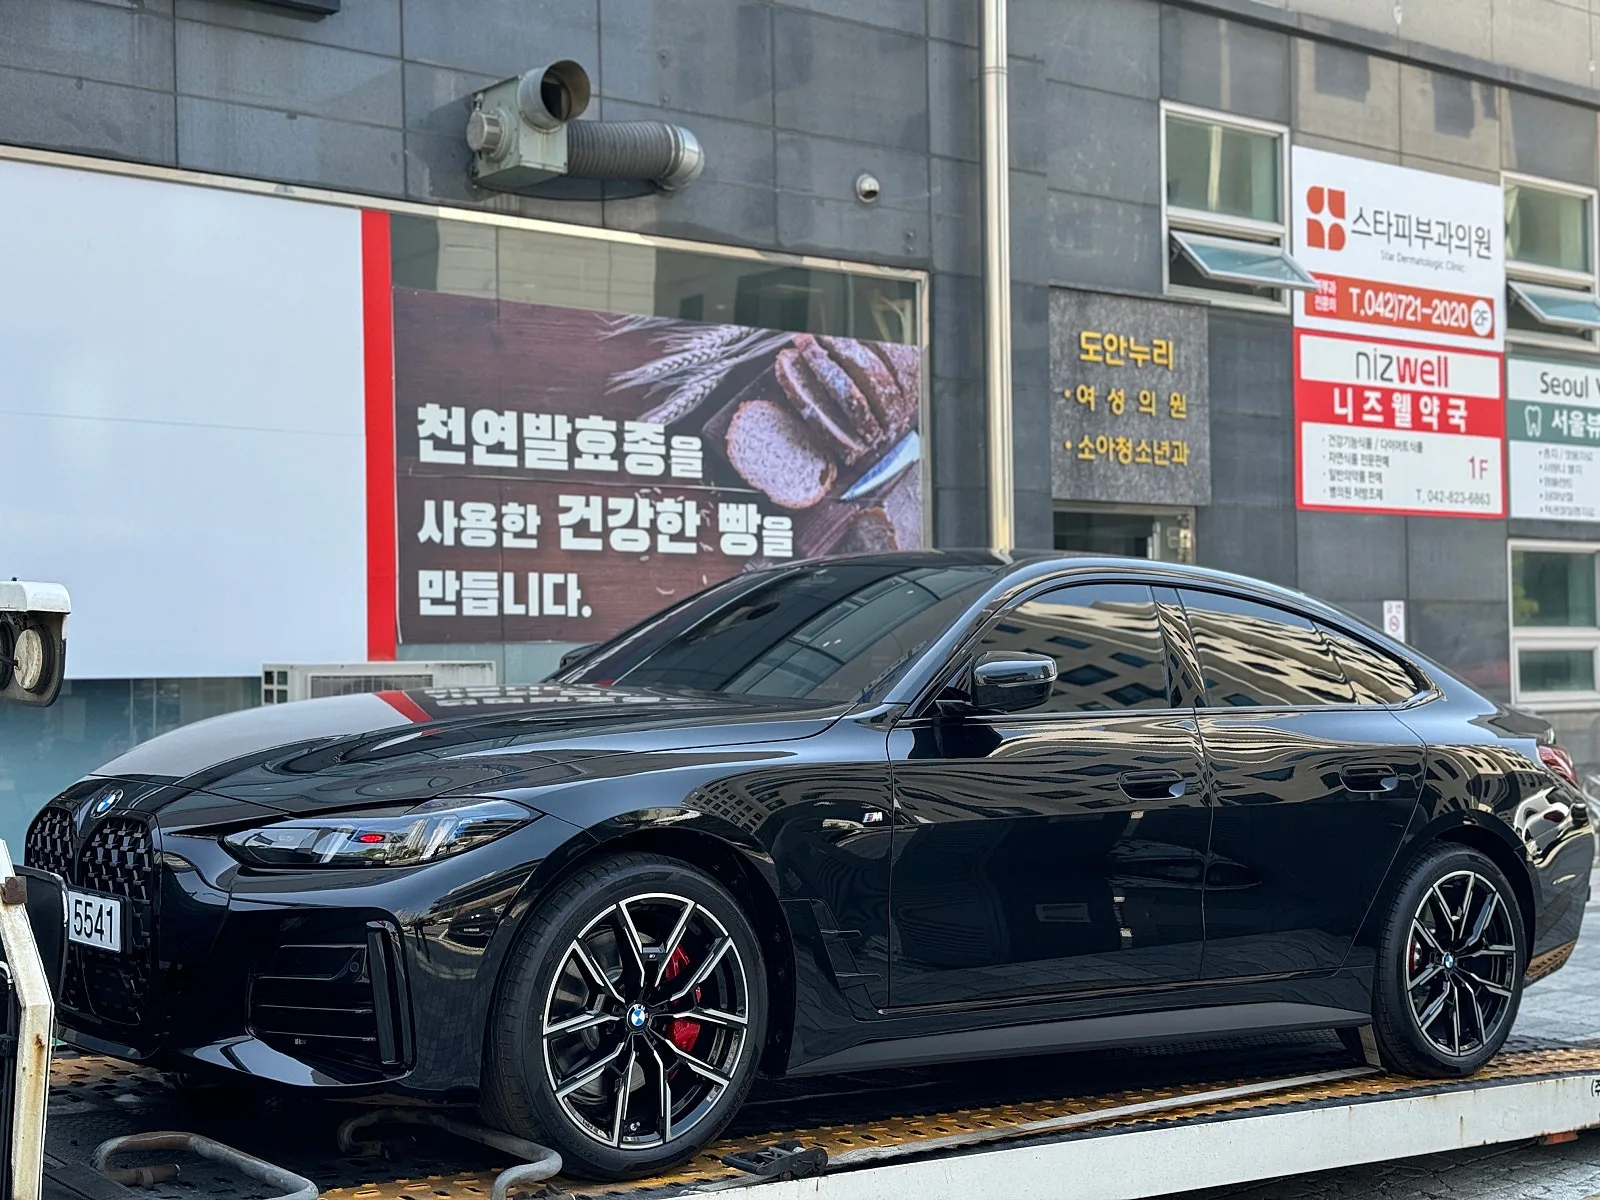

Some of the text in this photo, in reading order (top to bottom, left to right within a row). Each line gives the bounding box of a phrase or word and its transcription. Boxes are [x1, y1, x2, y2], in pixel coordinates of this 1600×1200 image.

[1351, 207, 1492, 260] 스타피부과의원
[1348, 287, 1489, 329] T.042)721-2020 2F
[1080, 331, 1174, 371] 도안누리
[1356, 348, 1449, 388] nizwell
[1540, 372, 1589, 399] Seoul
[417, 403, 703, 479] 천연발효종을
[1077, 434, 1190, 467] 소아청소년과
[1468, 456, 1489, 480] 1F
[417, 494, 794, 558] 사용한 건강한 빵을
[418, 569, 592, 618] 만듭니다.
[74, 899, 113, 943] 5541
